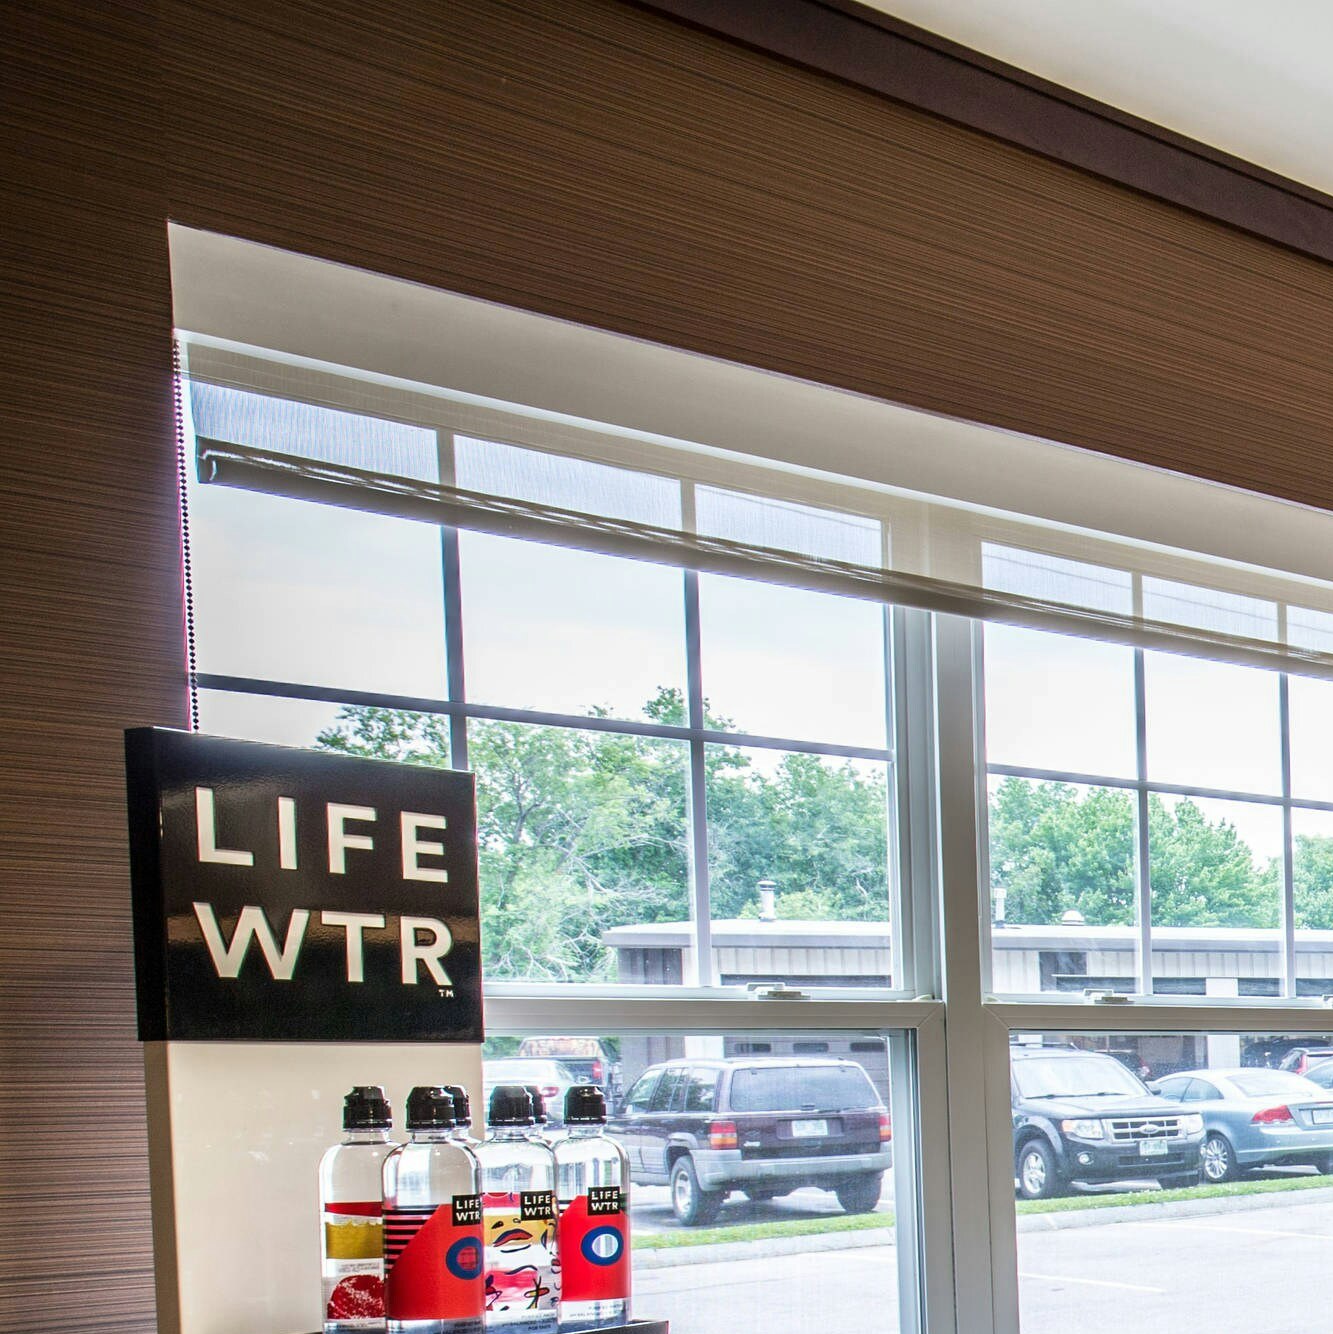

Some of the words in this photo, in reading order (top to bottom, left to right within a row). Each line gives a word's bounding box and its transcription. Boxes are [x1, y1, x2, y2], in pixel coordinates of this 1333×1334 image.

[194, 785, 449, 884] LIFE
[192, 901, 454, 986] WTR
[523, 1193, 552, 1206] LIFE
[590, 1189, 620, 1202] LIFE
[455, 1198, 481, 1211] LIFE
[590, 1201, 620, 1213] WTR
[455, 1210, 481, 1223] WTR
[523, 1205, 552, 1218] WTR
